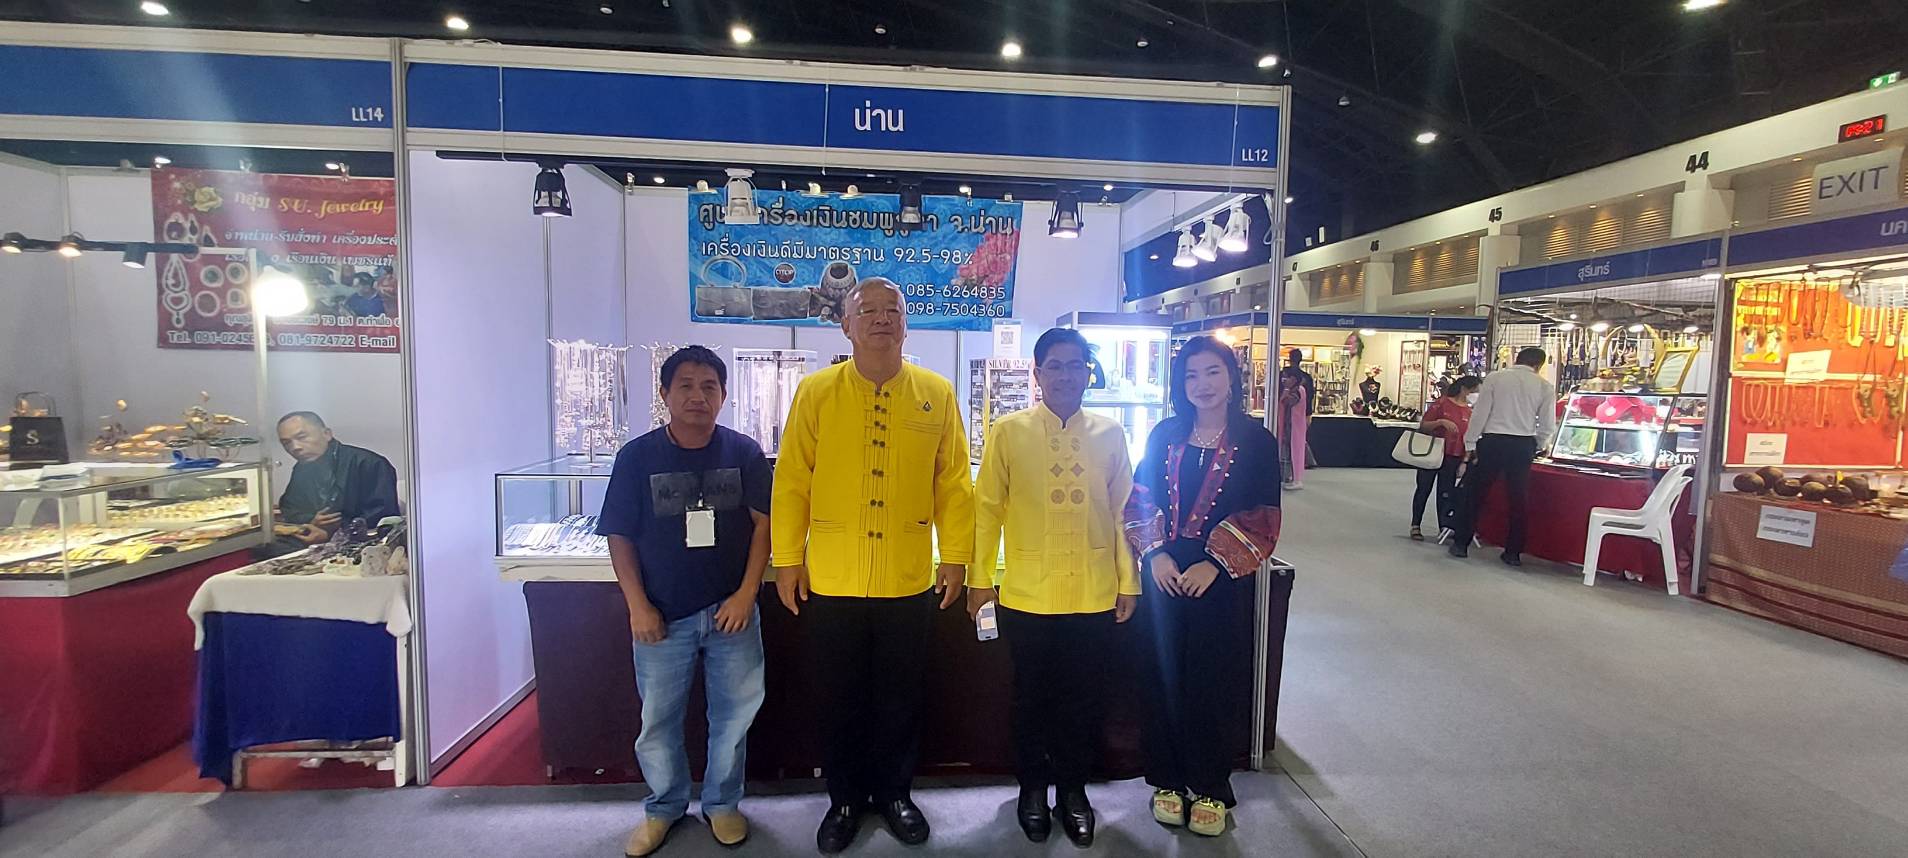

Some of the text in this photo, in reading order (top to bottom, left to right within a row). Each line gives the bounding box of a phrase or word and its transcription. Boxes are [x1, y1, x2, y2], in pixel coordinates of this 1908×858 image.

[352, 107, 384, 122] LL14
[854, 100, 904, 132] น่าน
[1242, 148, 1268, 162] LL12
[1685, 151, 1709, 173] 44
[1818, 166, 1889, 200] EXIT
[315, 198, 385, 219] Jewelry
[1488, 206, 1502, 223] 45
[950, 209, 1014, 236] จ.น่าน
[702, 232, 974, 265] เครื่องเงินดีมีมาตรฐาน 92.5-98%
[1577, 261, 1610, 281] สุรินทร์
[906, 302, 1005, 317] 098-7504360
[168, 331, 191, 344] Tel.
[359, 335, 398, 348] E-mail
